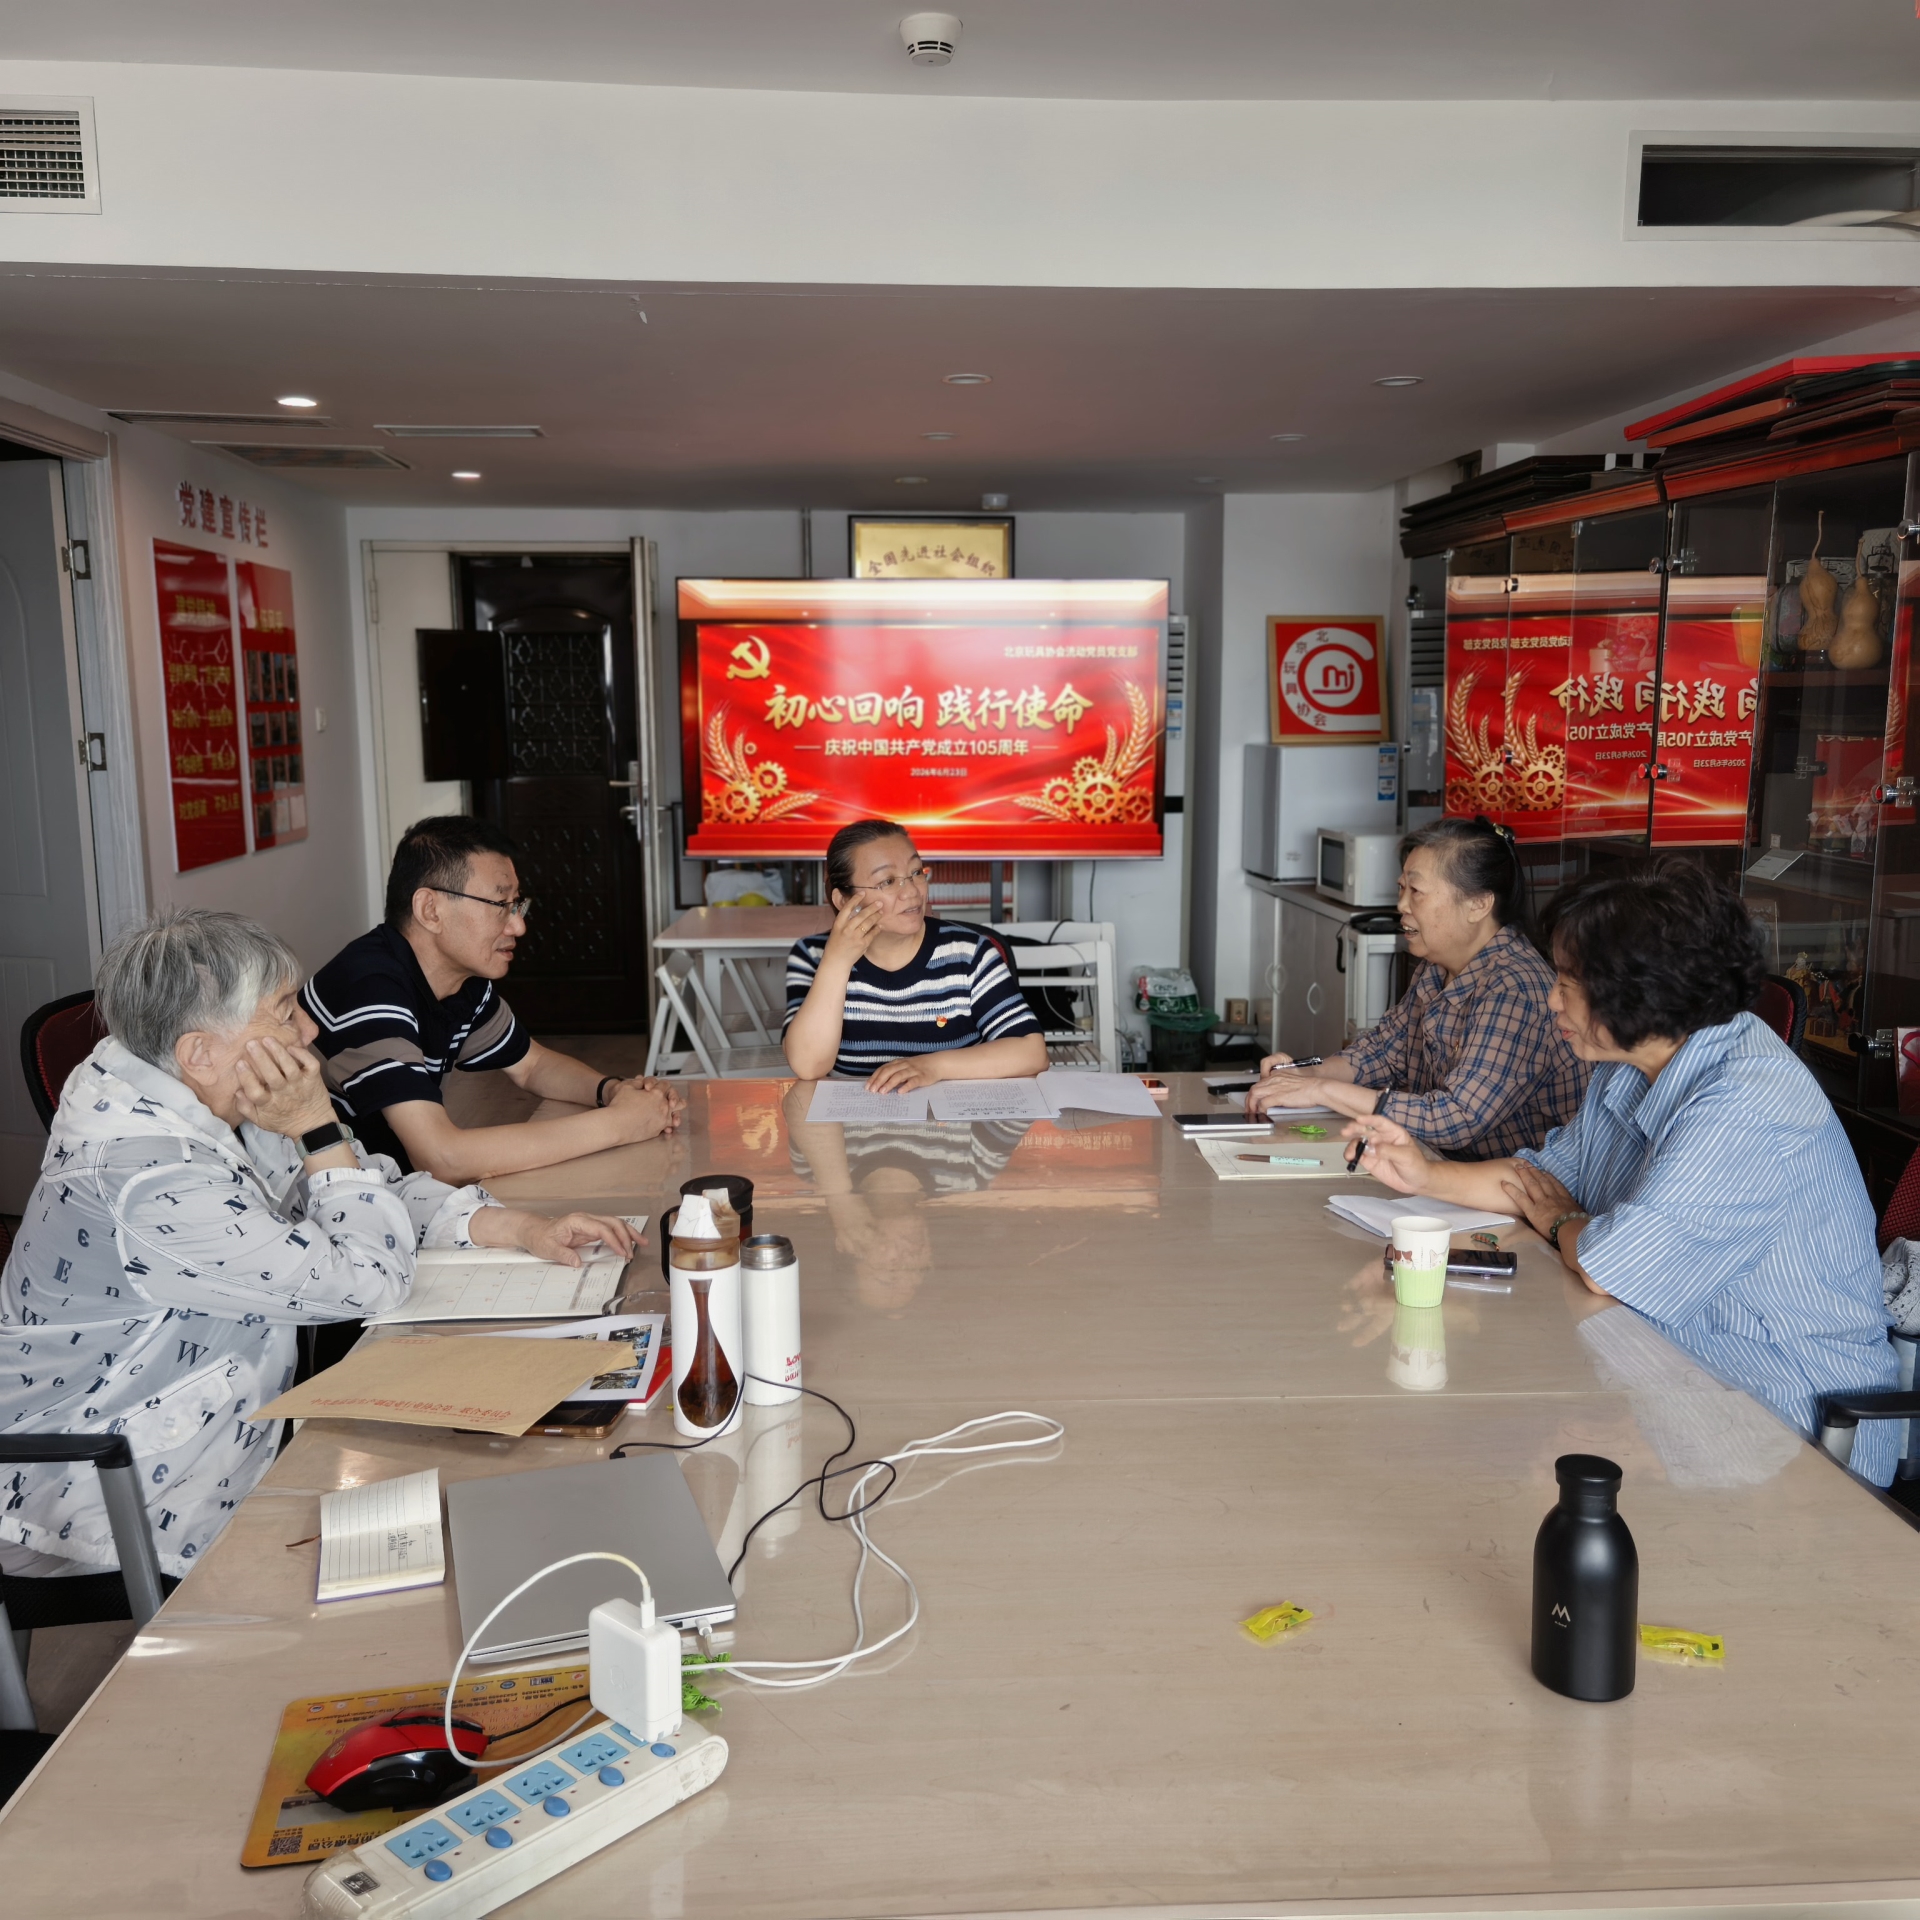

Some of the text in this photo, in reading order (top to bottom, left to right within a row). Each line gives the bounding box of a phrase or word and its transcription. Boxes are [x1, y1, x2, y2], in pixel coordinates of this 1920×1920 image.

[178, 480, 268, 548] 党建宣传栏
[868, 544, 996, 577] 全国先进社会组织
[1283, 630, 1329, 727] 北京玩具协会
[764, 682, 1094, 735] 初心回响 践行使命
[824, 739, 1028, 757] 庆祝中国共产党成立105周年
[910, 767, 967, 778] 2026年6月23日
[308, 1832, 380, 1851] 份有限公司
